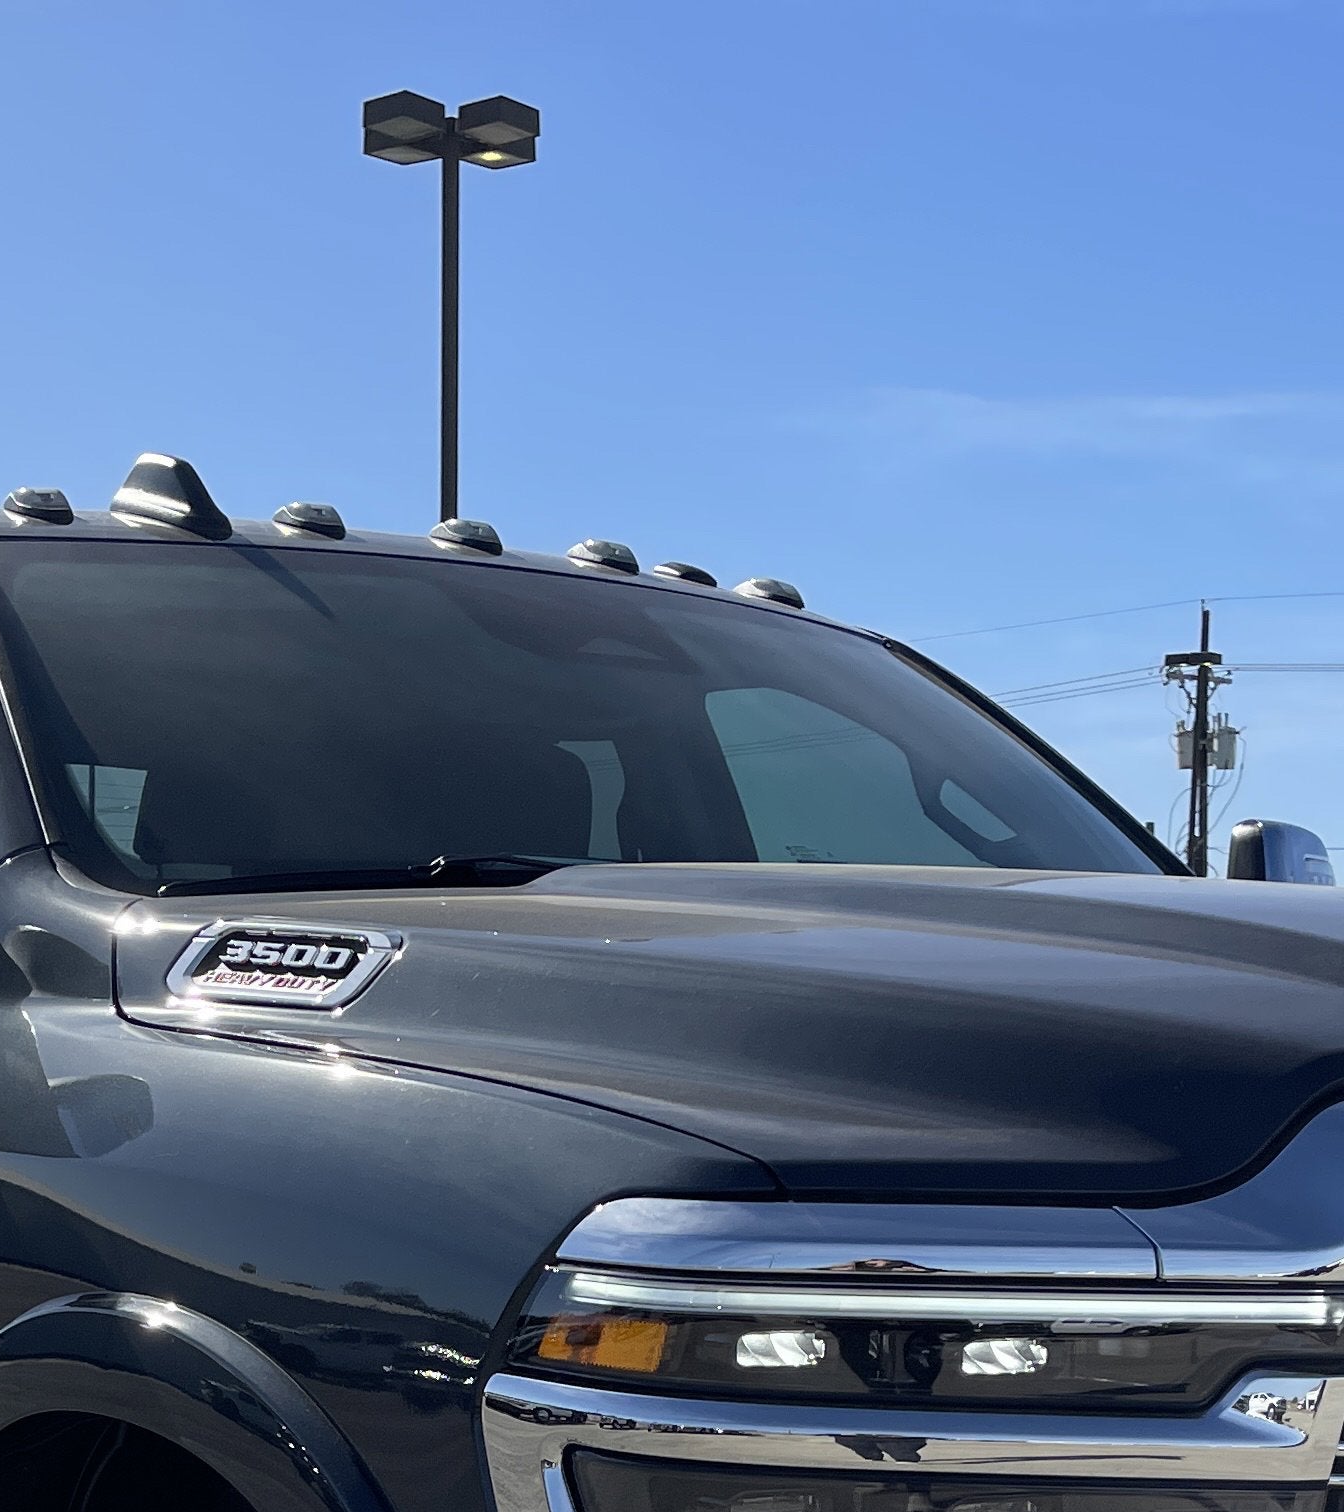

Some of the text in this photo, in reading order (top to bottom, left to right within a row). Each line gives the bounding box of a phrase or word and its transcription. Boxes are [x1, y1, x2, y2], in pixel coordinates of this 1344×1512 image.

[218, 939, 354, 970] 3500
[202, 970, 338, 991] HEAVY DUTY
